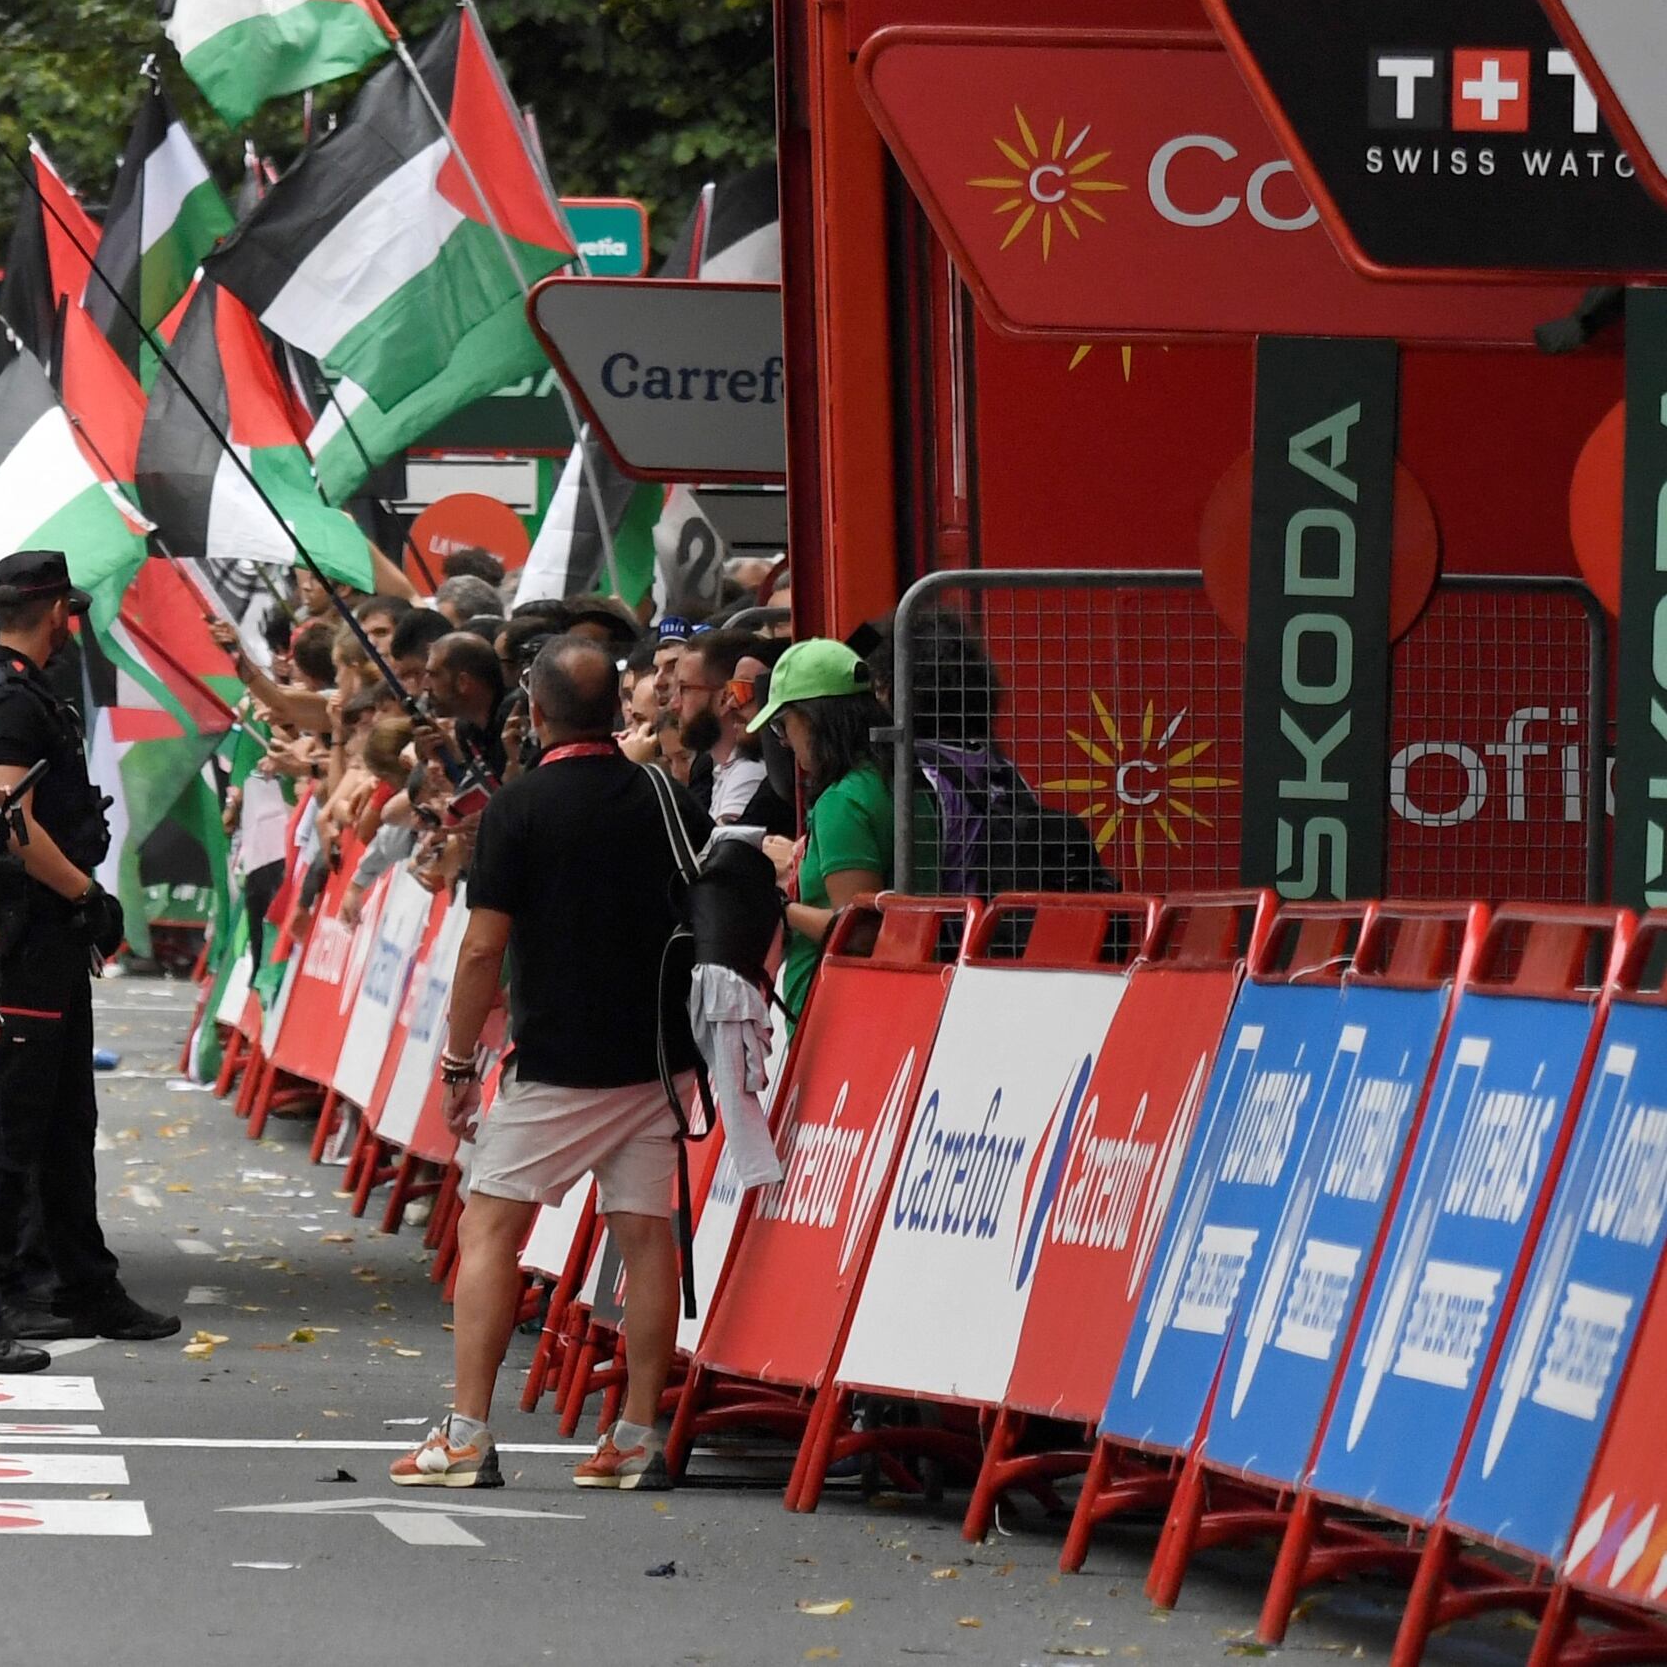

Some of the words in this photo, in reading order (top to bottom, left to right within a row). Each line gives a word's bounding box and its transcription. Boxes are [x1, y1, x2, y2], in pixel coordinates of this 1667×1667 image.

[1366, 146, 1496, 177] SWISS
[892, 1086, 1027, 1240] Carrefour
[1051, 1091, 1158, 1252] Carrefour
